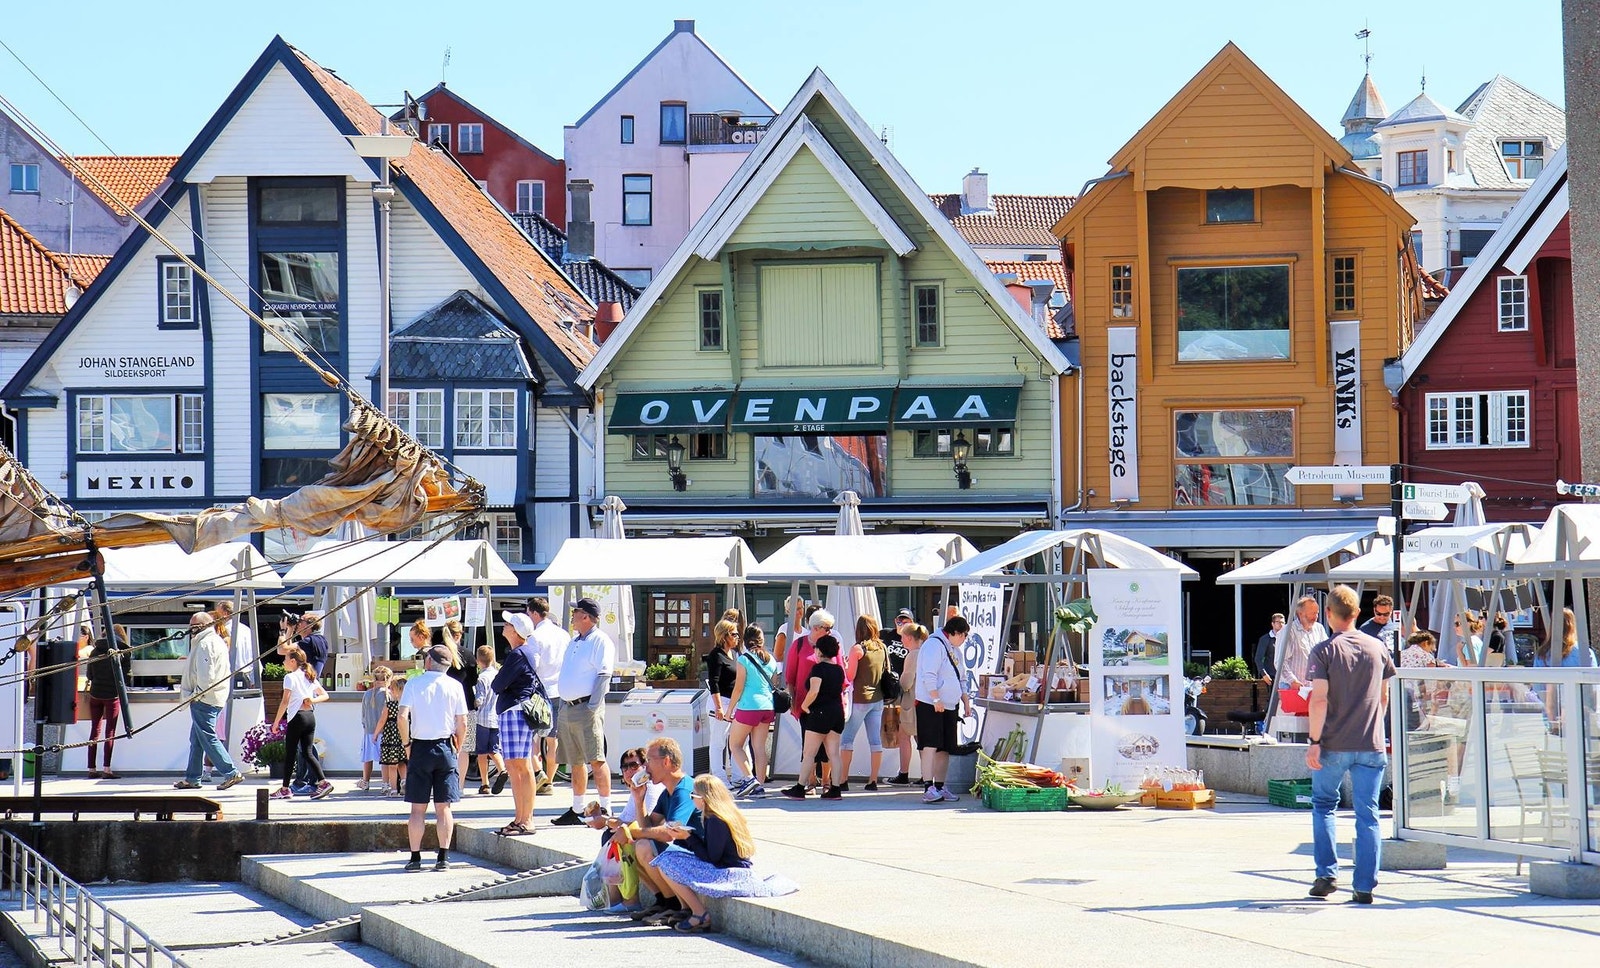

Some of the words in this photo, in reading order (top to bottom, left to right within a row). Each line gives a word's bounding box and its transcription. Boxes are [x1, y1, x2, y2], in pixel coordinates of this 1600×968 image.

[79, 357, 116, 368] JOHAN
[119, 356, 195, 368] STANGELAND
[104, 369, 166, 377] SILDEEKSPORT
[1109, 354, 1136, 478] backstage
[1298, 470, 1343, 479] Petroleum
[1347, 470, 1385, 479] Museum
[1419, 487, 1442, 497] Tourist
[1445, 488, 1459, 498] Info
[1430, 539, 1442, 548] 60
[962, 590, 986, 603] Skinka
[962, 604, 996, 628] Suldal
